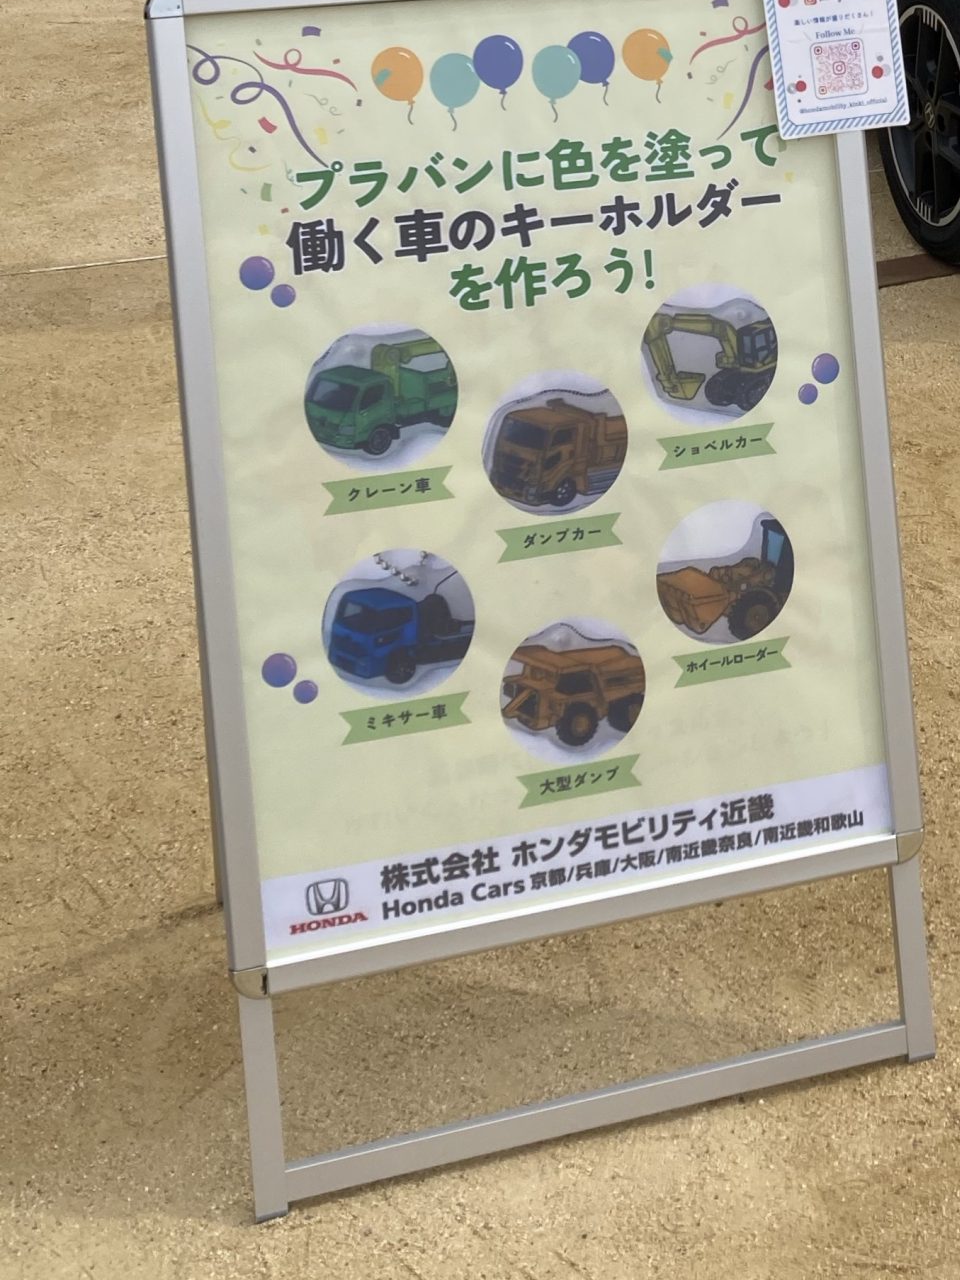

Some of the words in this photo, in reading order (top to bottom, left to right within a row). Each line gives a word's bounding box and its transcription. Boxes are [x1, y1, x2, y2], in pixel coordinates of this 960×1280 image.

[815, 30, 841, 40] Follow
[843, 28, 856, 36] Me
[296, 125, 779, 211] プラバンに色を塗って
[285, 179, 782, 275] 働く車のキーホルダー
[449, 247, 656, 311] を作ろう!
[673, 435, 762, 458] ショベルカー
[348, 477, 432, 502] クレーン車
[523, 527, 602, 549] ダンプカー
[686, 647, 778, 673] ホイールローダー
[366, 703, 448, 730] ミキサー車
[539, 766, 620, 795] 大型ダンプ
[380, 846, 500, 893] 株式会社
[511, 793, 775, 867] ホンダモビリティ近畿
[382, 890, 465, 920] Honda
[471, 878, 526, 903] Cars
[289, 911, 369, 935] HONDA
